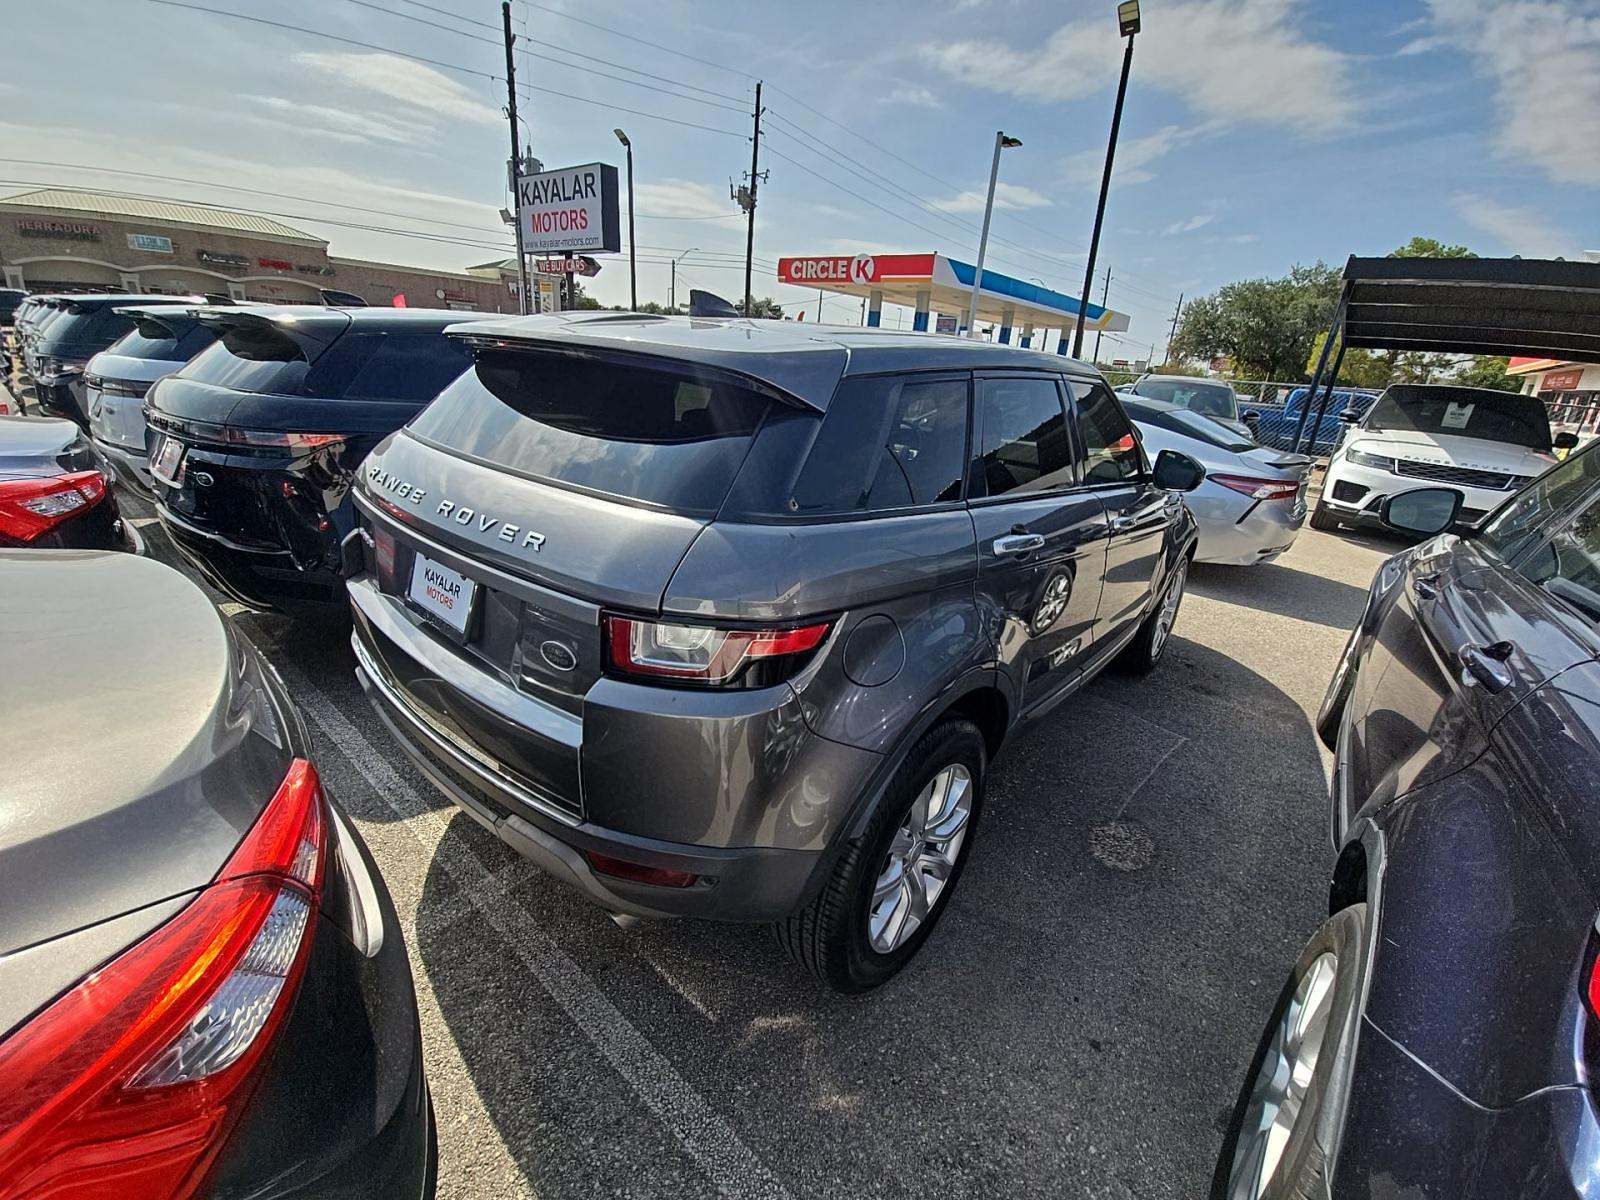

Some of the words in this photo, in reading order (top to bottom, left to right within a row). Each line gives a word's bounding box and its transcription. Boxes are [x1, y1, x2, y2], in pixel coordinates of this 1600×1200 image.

[519, 172, 597, 206] KAYALAR
[16, 220, 100, 234] HERRADURA
[531, 208, 588, 234] MOTORS
[525, 236, 600, 250] www.kayalar-motors.com
[538, 260, 551, 272] WE
[551, 260, 565, 271] BUY
[565, 259, 586, 271] CARS
[790, 260, 848, 279] CIRCLE
[855, 259, 872, 283] K
[369, 466, 426, 504] RANGE
[436, 499, 547, 552] ROVER
[424, 566, 461, 599] KAYALAR
[426, 585, 454, 610] MOTORS
